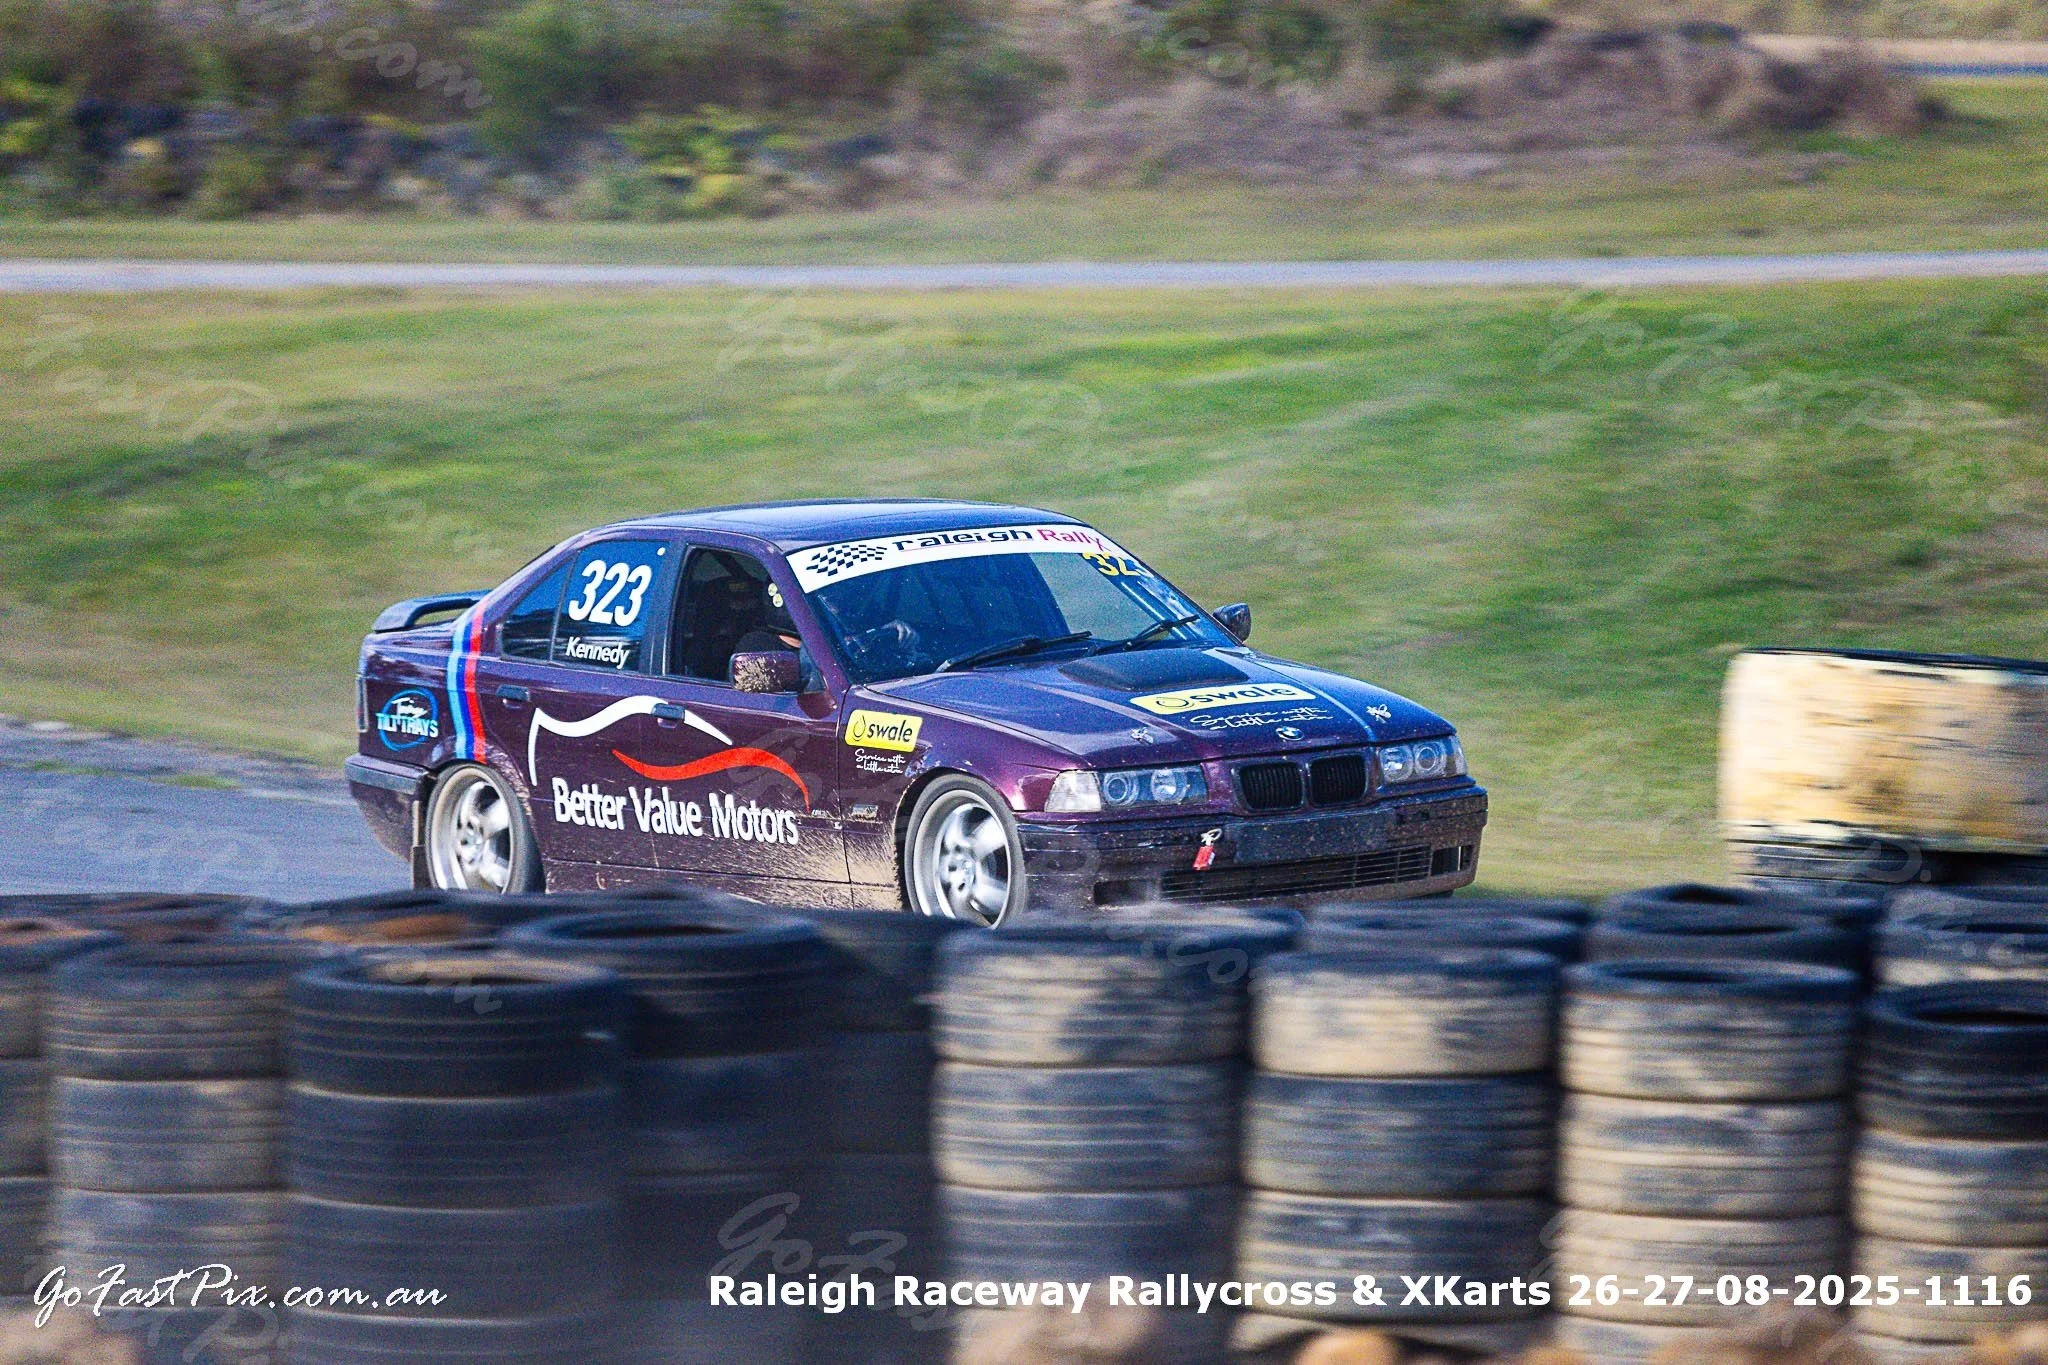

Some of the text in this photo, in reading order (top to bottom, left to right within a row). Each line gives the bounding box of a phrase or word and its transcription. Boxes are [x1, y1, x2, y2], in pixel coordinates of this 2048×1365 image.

[892, 529, 1111, 552] raleigh Rally
[568, 559, 652, 627] 323
[565, 636, 630, 670] Kennedy
[1190, 686, 1296, 703] swale
[401, 716, 439, 738] TRAYS
[867, 720, 913, 742] swale
[854, 748, 887, 762] Service
[552, 777, 799, 845] Better Value Motors
